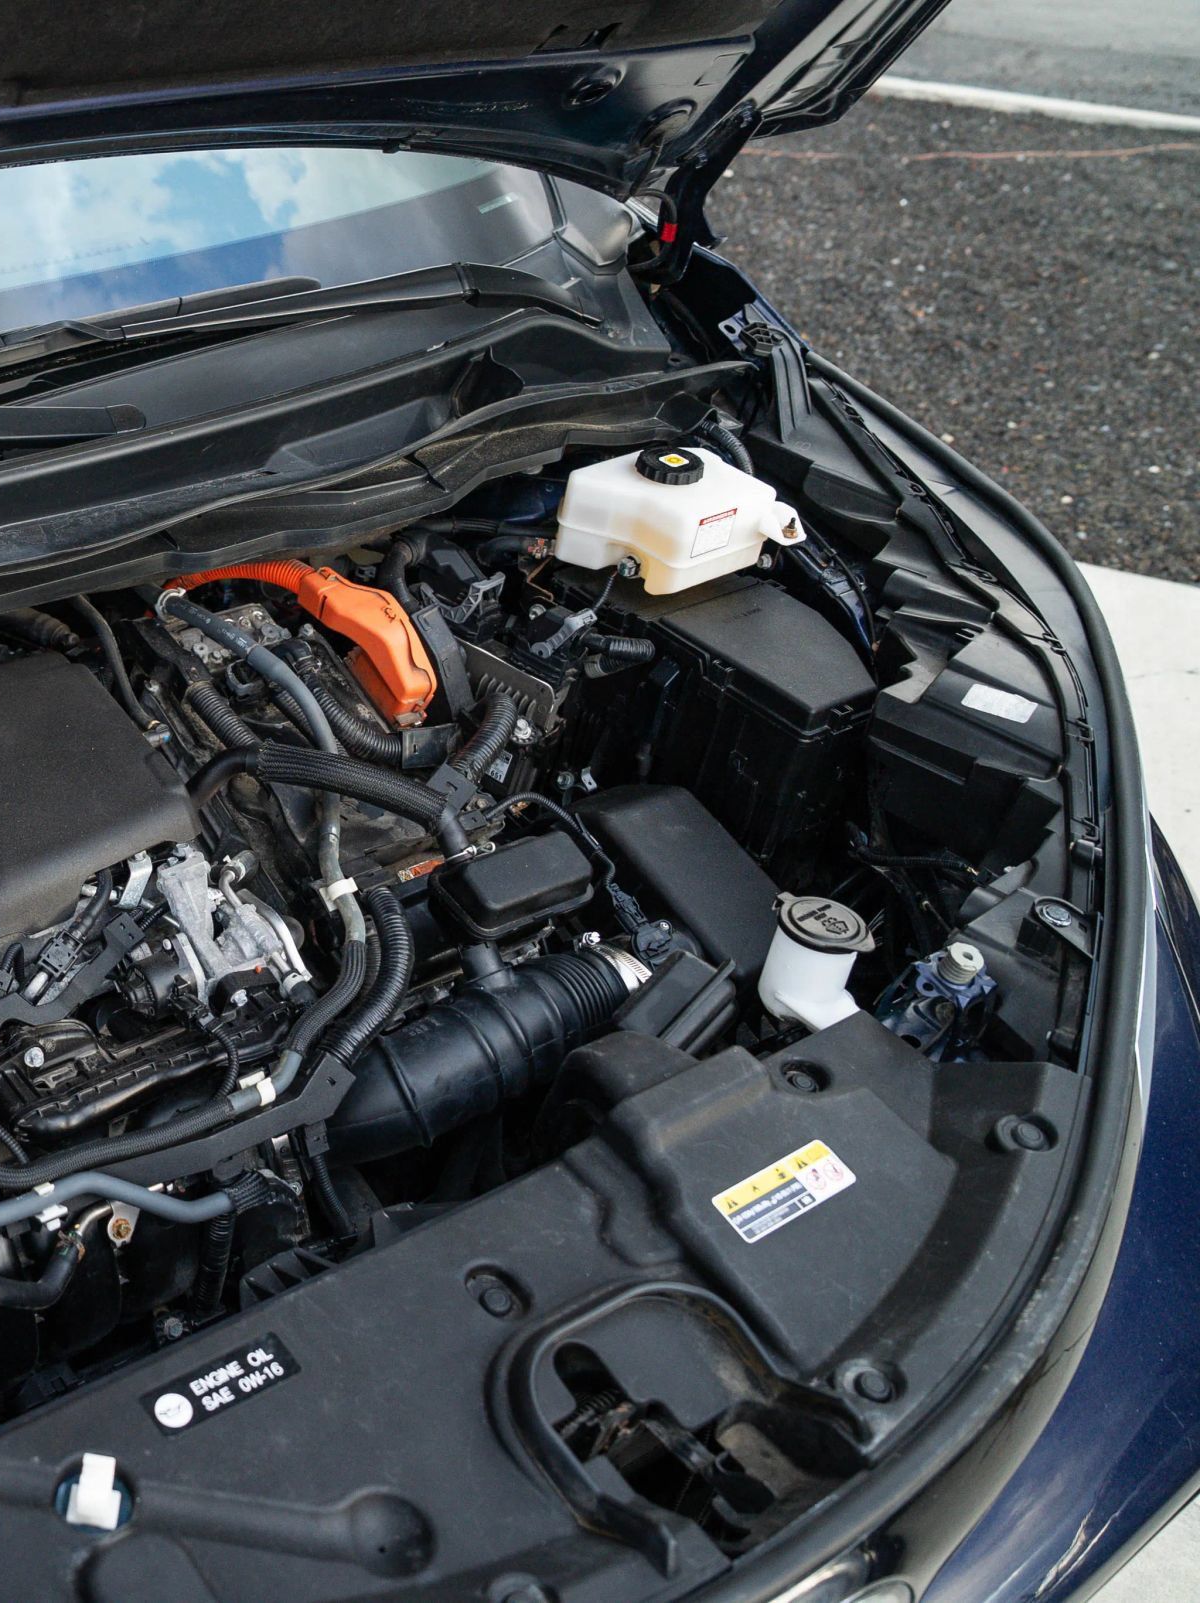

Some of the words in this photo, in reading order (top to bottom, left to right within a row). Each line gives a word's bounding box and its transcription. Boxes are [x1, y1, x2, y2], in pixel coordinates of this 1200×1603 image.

[189, 1360, 245, 1396] ENGINE
[246, 1348, 274, 1367] OIL
[201, 1386, 236, 1412] SAE
[238, 1361, 284, 1393] 0W-16
